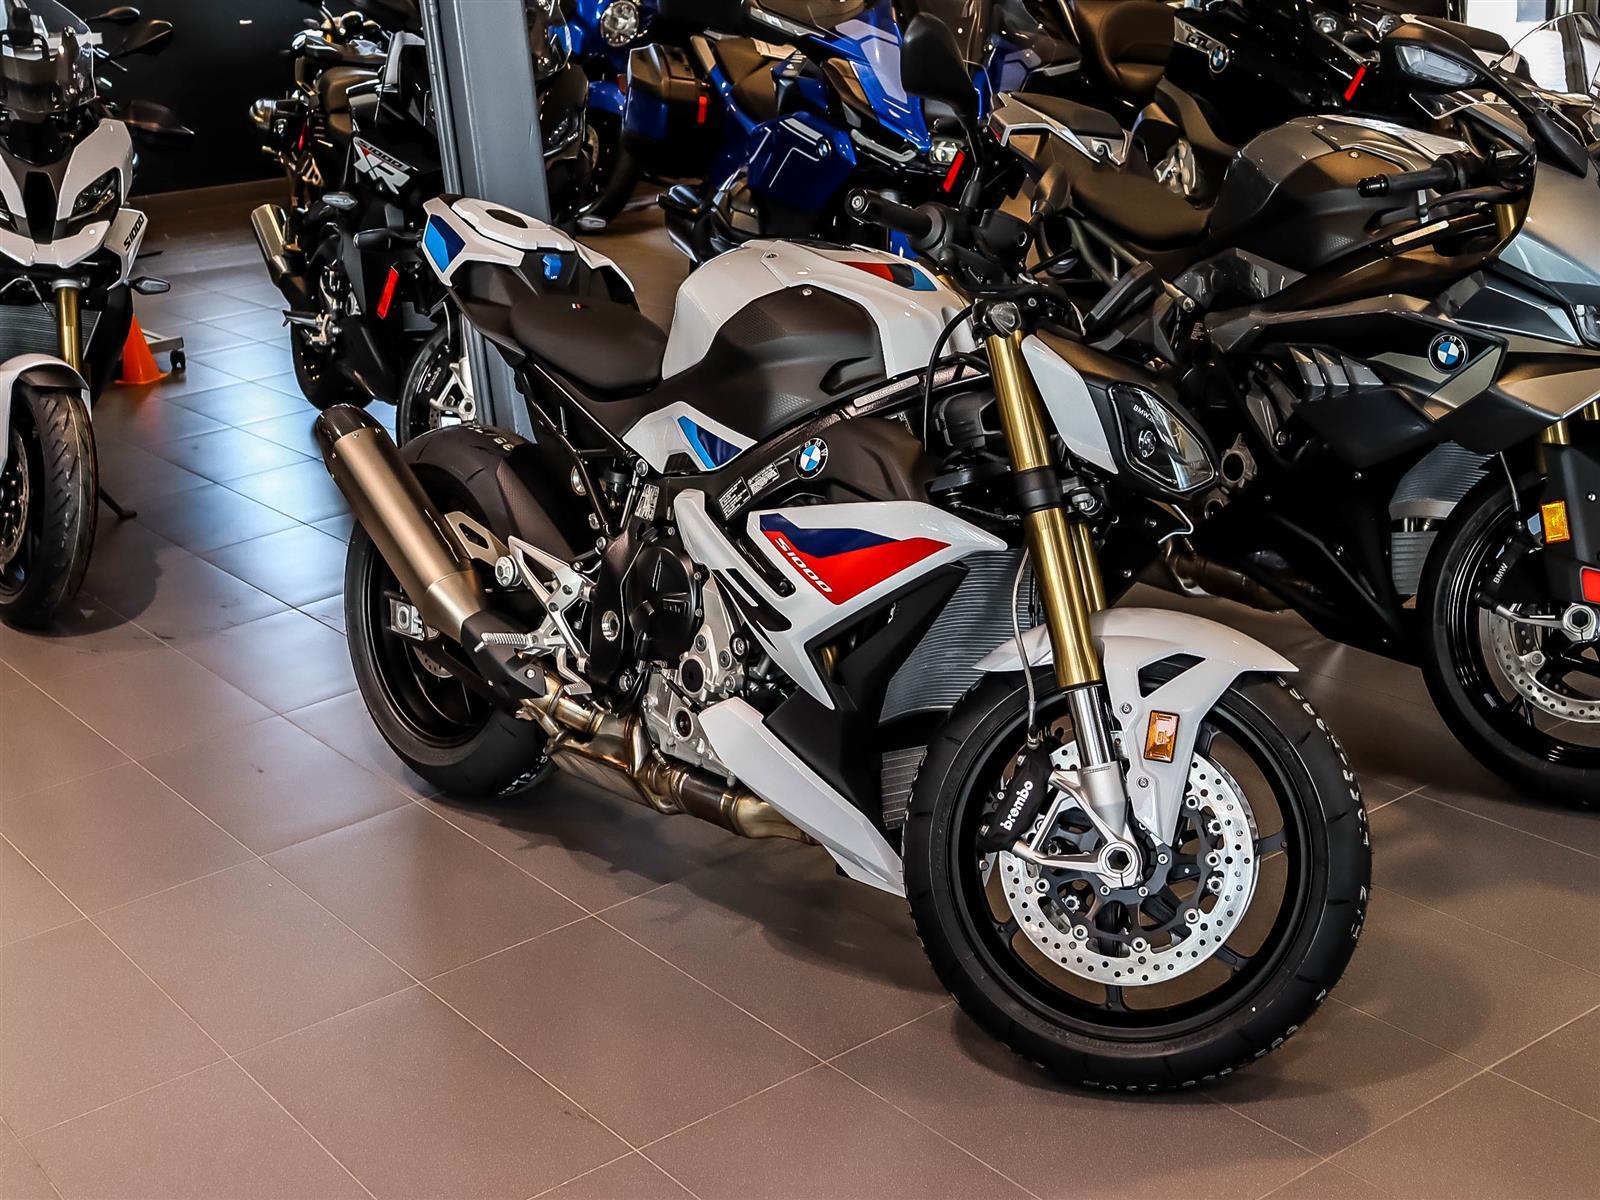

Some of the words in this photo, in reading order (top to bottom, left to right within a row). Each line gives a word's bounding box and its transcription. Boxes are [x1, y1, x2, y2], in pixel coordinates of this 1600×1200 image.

[123, 214, 145, 251] S1000
[774, 536, 833, 593] S1000
[1492, 562, 1508, 584] BMW
[1000, 780, 1034, 831] brembo
